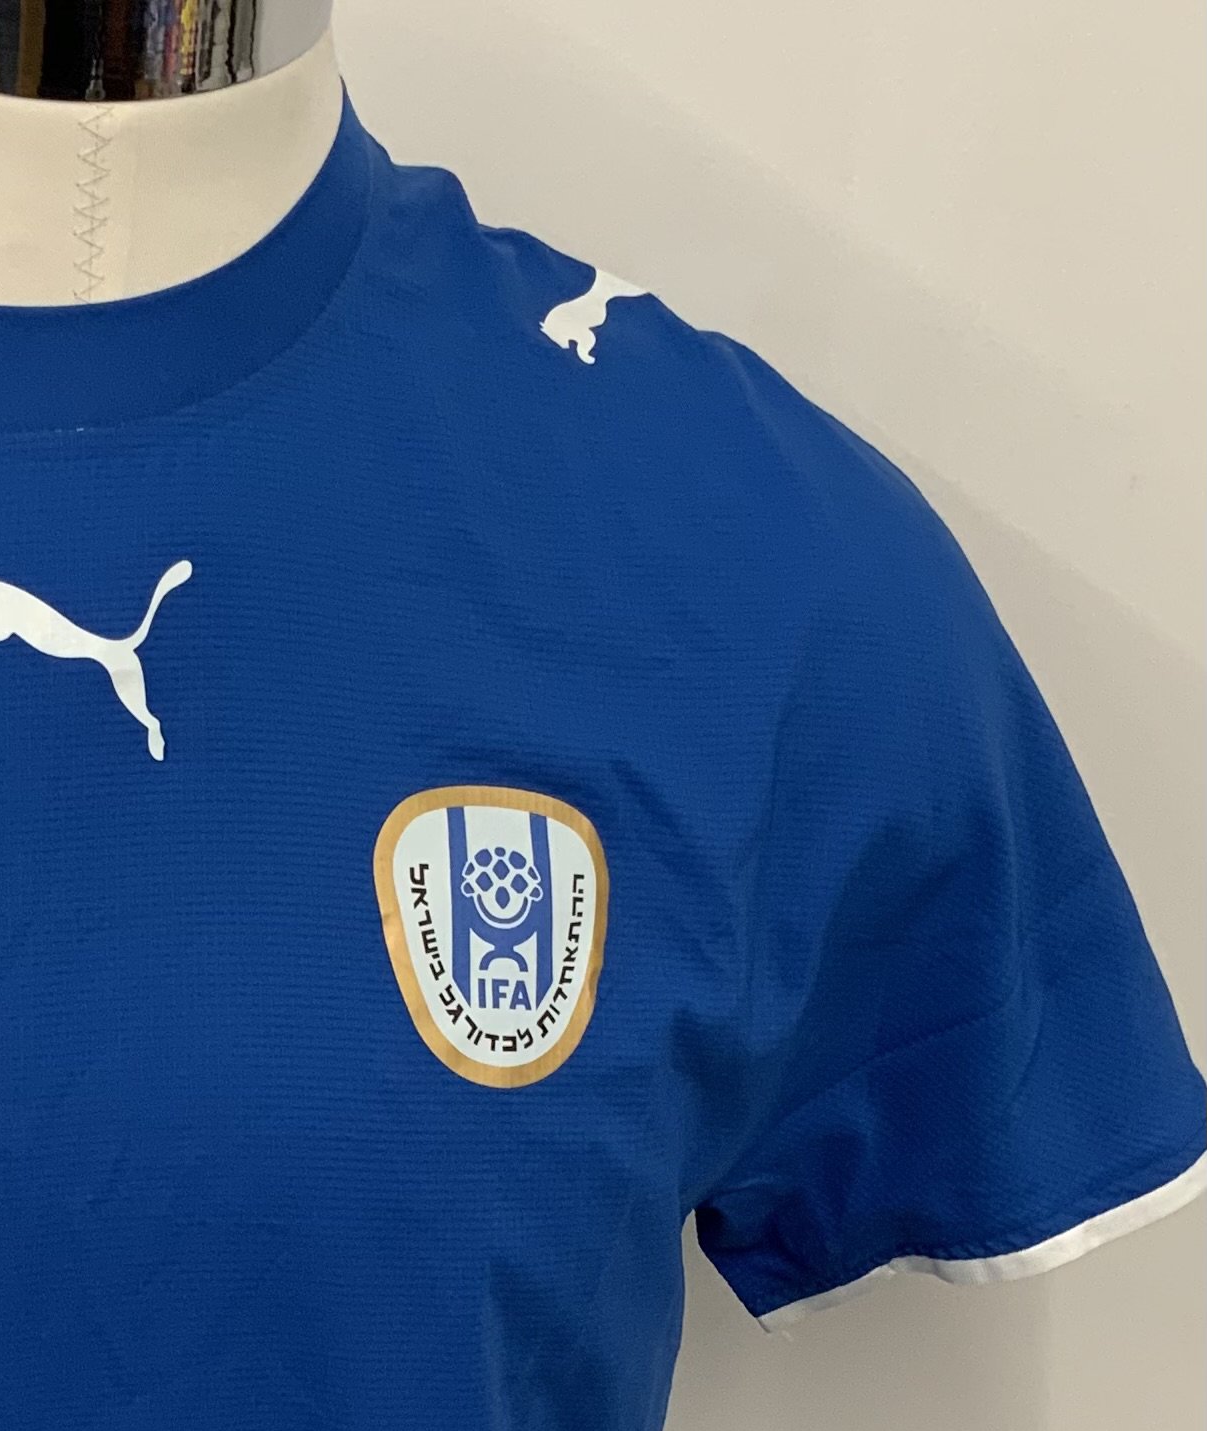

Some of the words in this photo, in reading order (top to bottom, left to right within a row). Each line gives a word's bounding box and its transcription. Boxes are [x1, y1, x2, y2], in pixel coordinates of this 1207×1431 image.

[409, 863, 446, 981] בישראל
[537, 874, 585, 1038] ההתאחדות
[439, 984, 534, 1052] לכדורגל
[478, 978, 532, 1011] IFA
